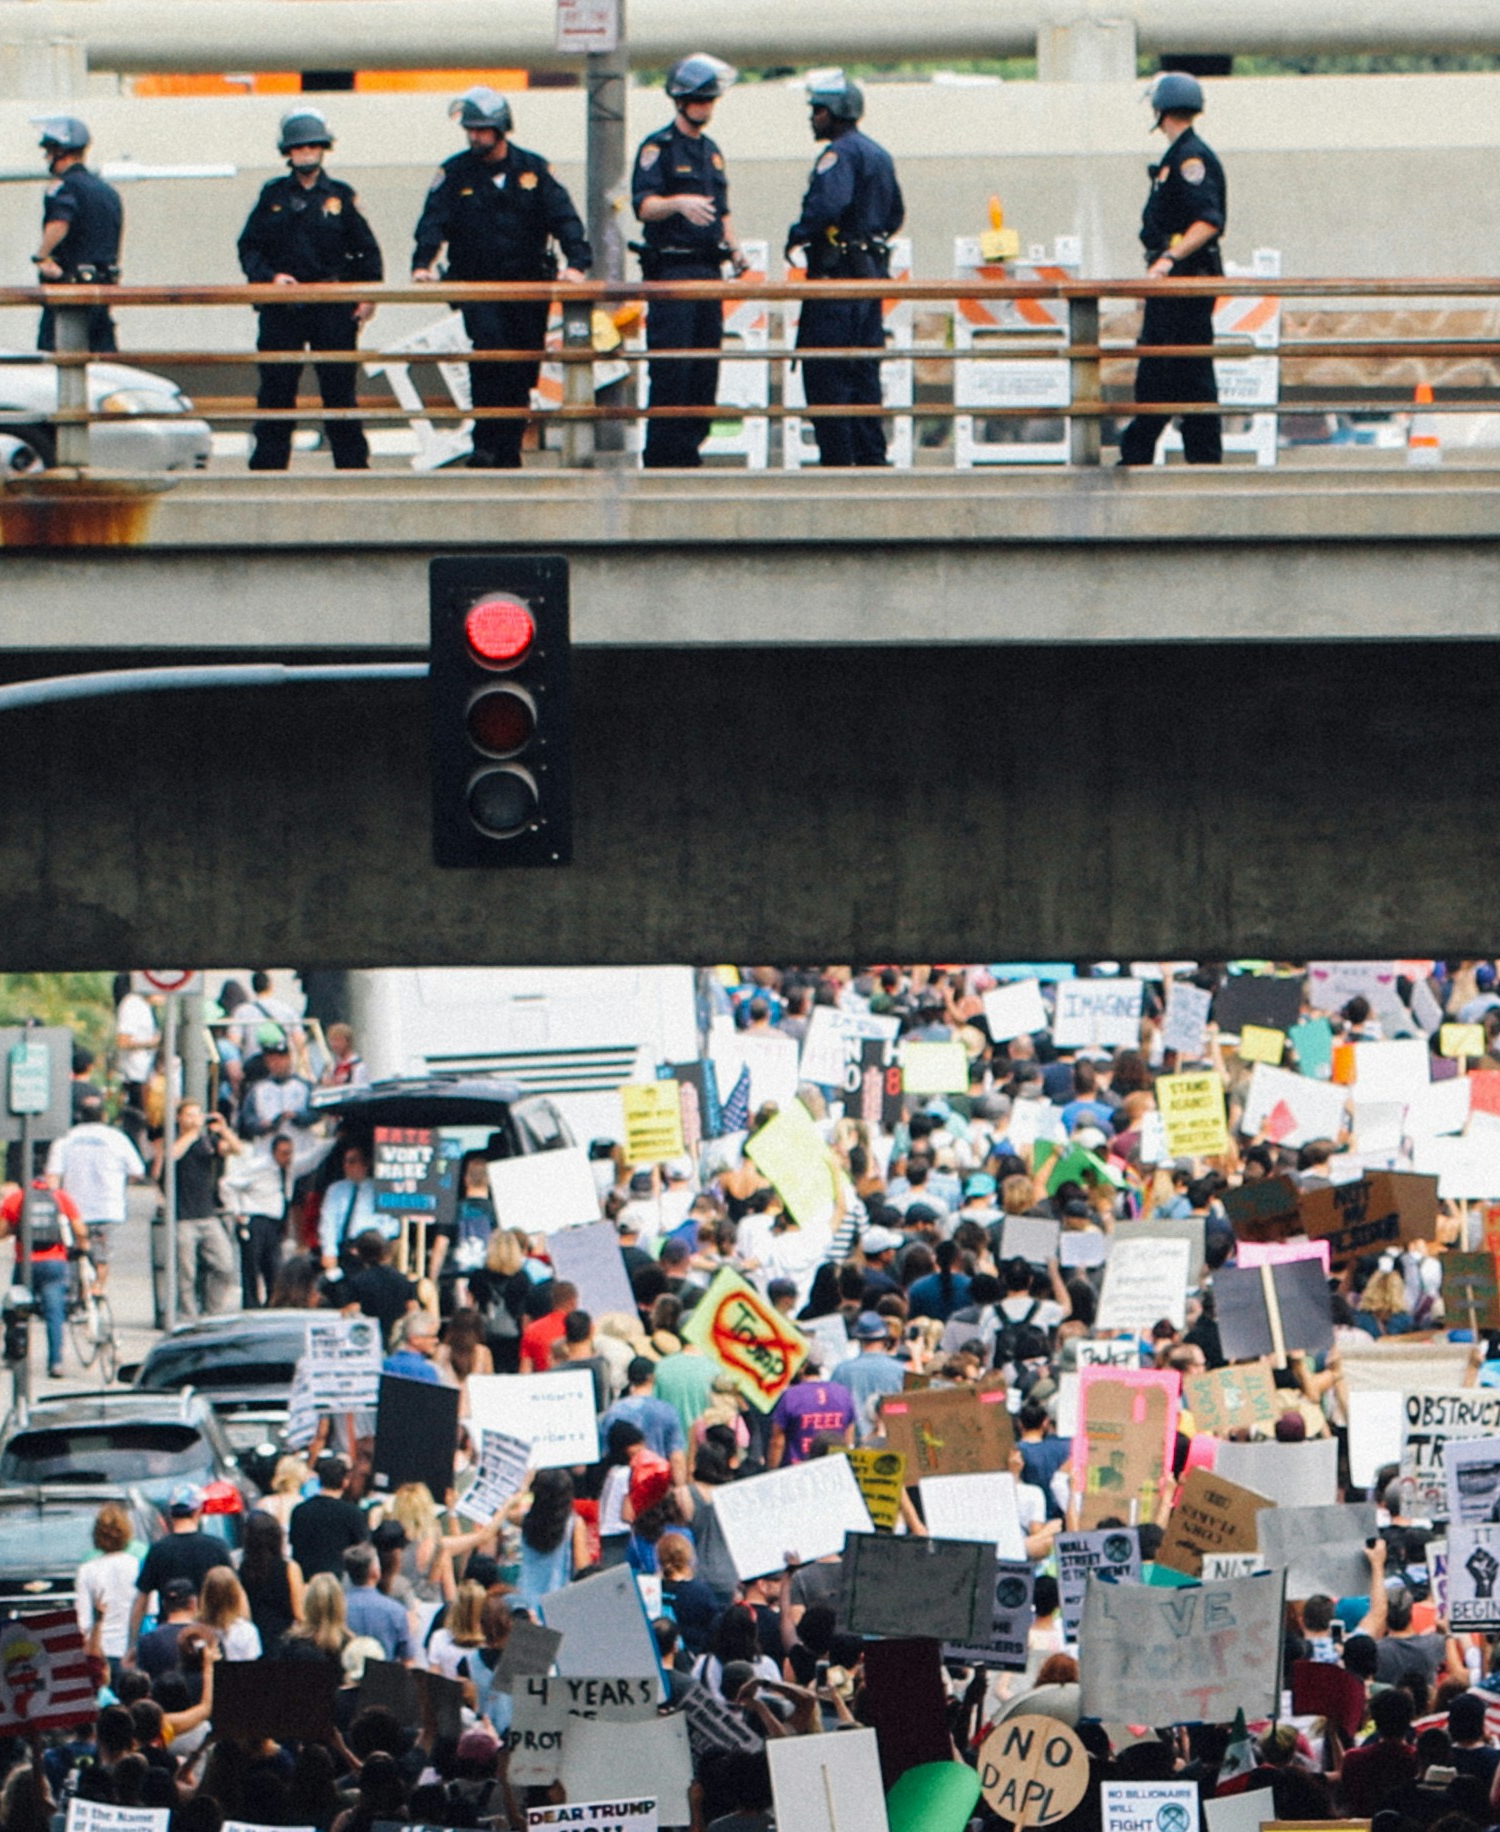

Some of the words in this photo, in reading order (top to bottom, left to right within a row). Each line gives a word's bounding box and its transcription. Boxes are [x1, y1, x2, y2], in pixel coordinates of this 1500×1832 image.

[1474, 1529, 1493, 1545] IT
[527, 1678, 548, 1704] 4
[568, 1678, 651, 1705] YEARS
[1002, 1725, 1073, 1767] NO
[982, 1762, 1062, 1820] DAPL
[530, 1807, 580, 1825] DEAR
[586, 1801, 656, 1822] TRUMP
